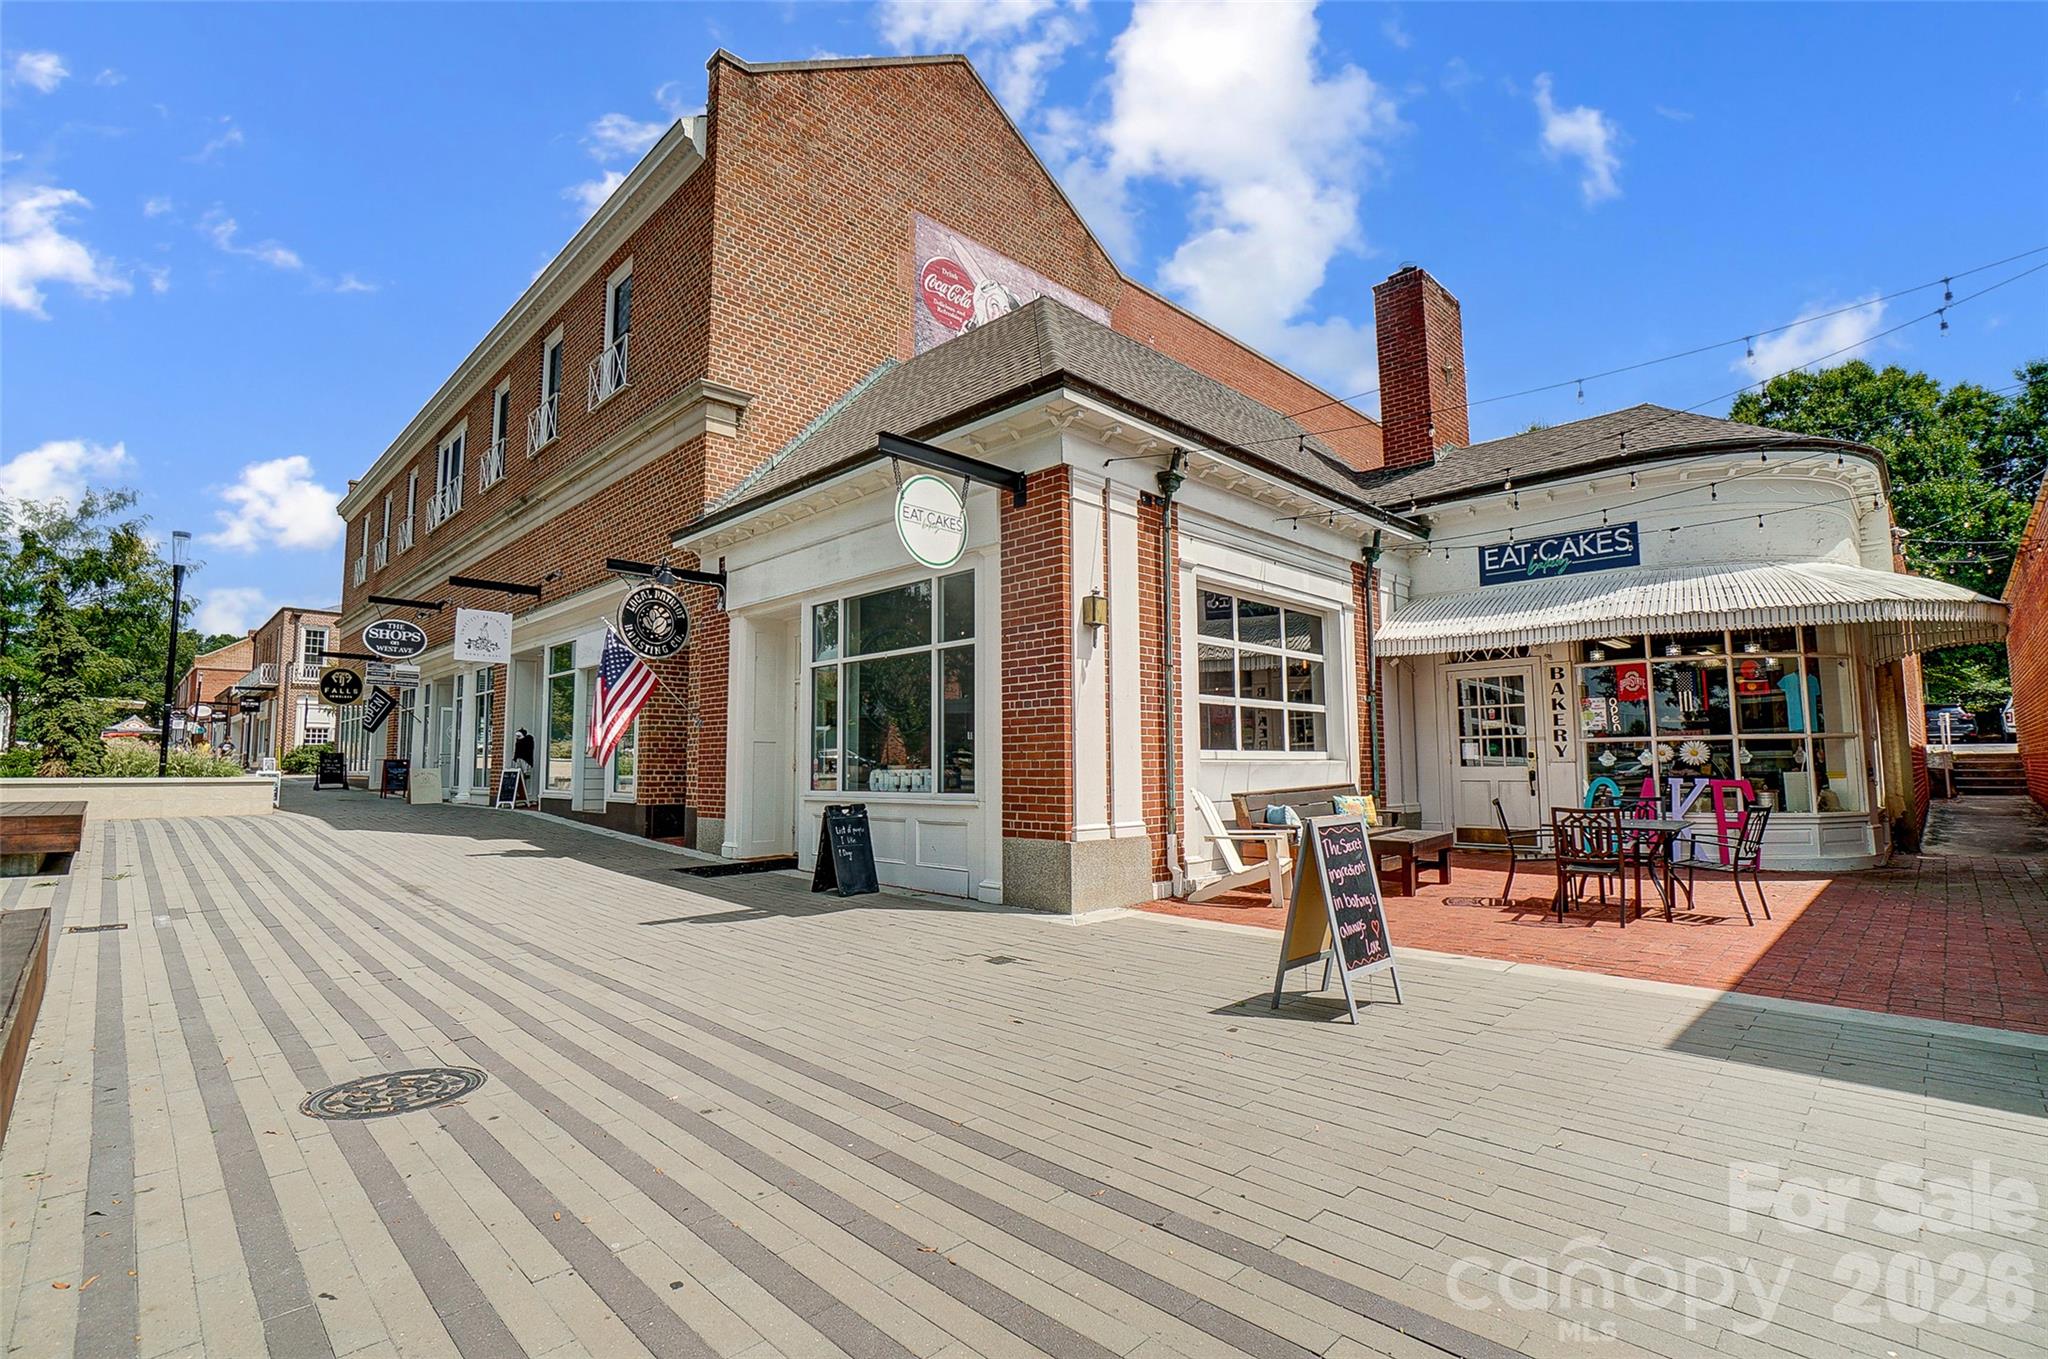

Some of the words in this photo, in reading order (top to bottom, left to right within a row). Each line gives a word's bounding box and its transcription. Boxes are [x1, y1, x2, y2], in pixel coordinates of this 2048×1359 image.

[903, 505, 924, 521] EAT
[927, 512, 963, 532] CAKES
[1485, 543, 1531, 570] EAT
[1538, 528, 1631, 561] CAKES
[626, 590, 653, 612] LOCAL
[654, 590, 685, 619] PATRIOT
[368, 627, 421, 643] SHOPS
[624, 623, 669, 655] ROASTING
[376, 645, 398, 653] WEST
[363, 696, 385, 723] OPEN
[1550, 667, 1568, 757] BAKERY
[1322, 838, 1342, 858] The
[1340, 838, 1363, 853] Secret
[1328, 860, 1367, 886] ingredient
[1332, 895, 1344, 911] in
[1343, 892, 1373, 912] baking
[1340, 919, 1367, 939] always
